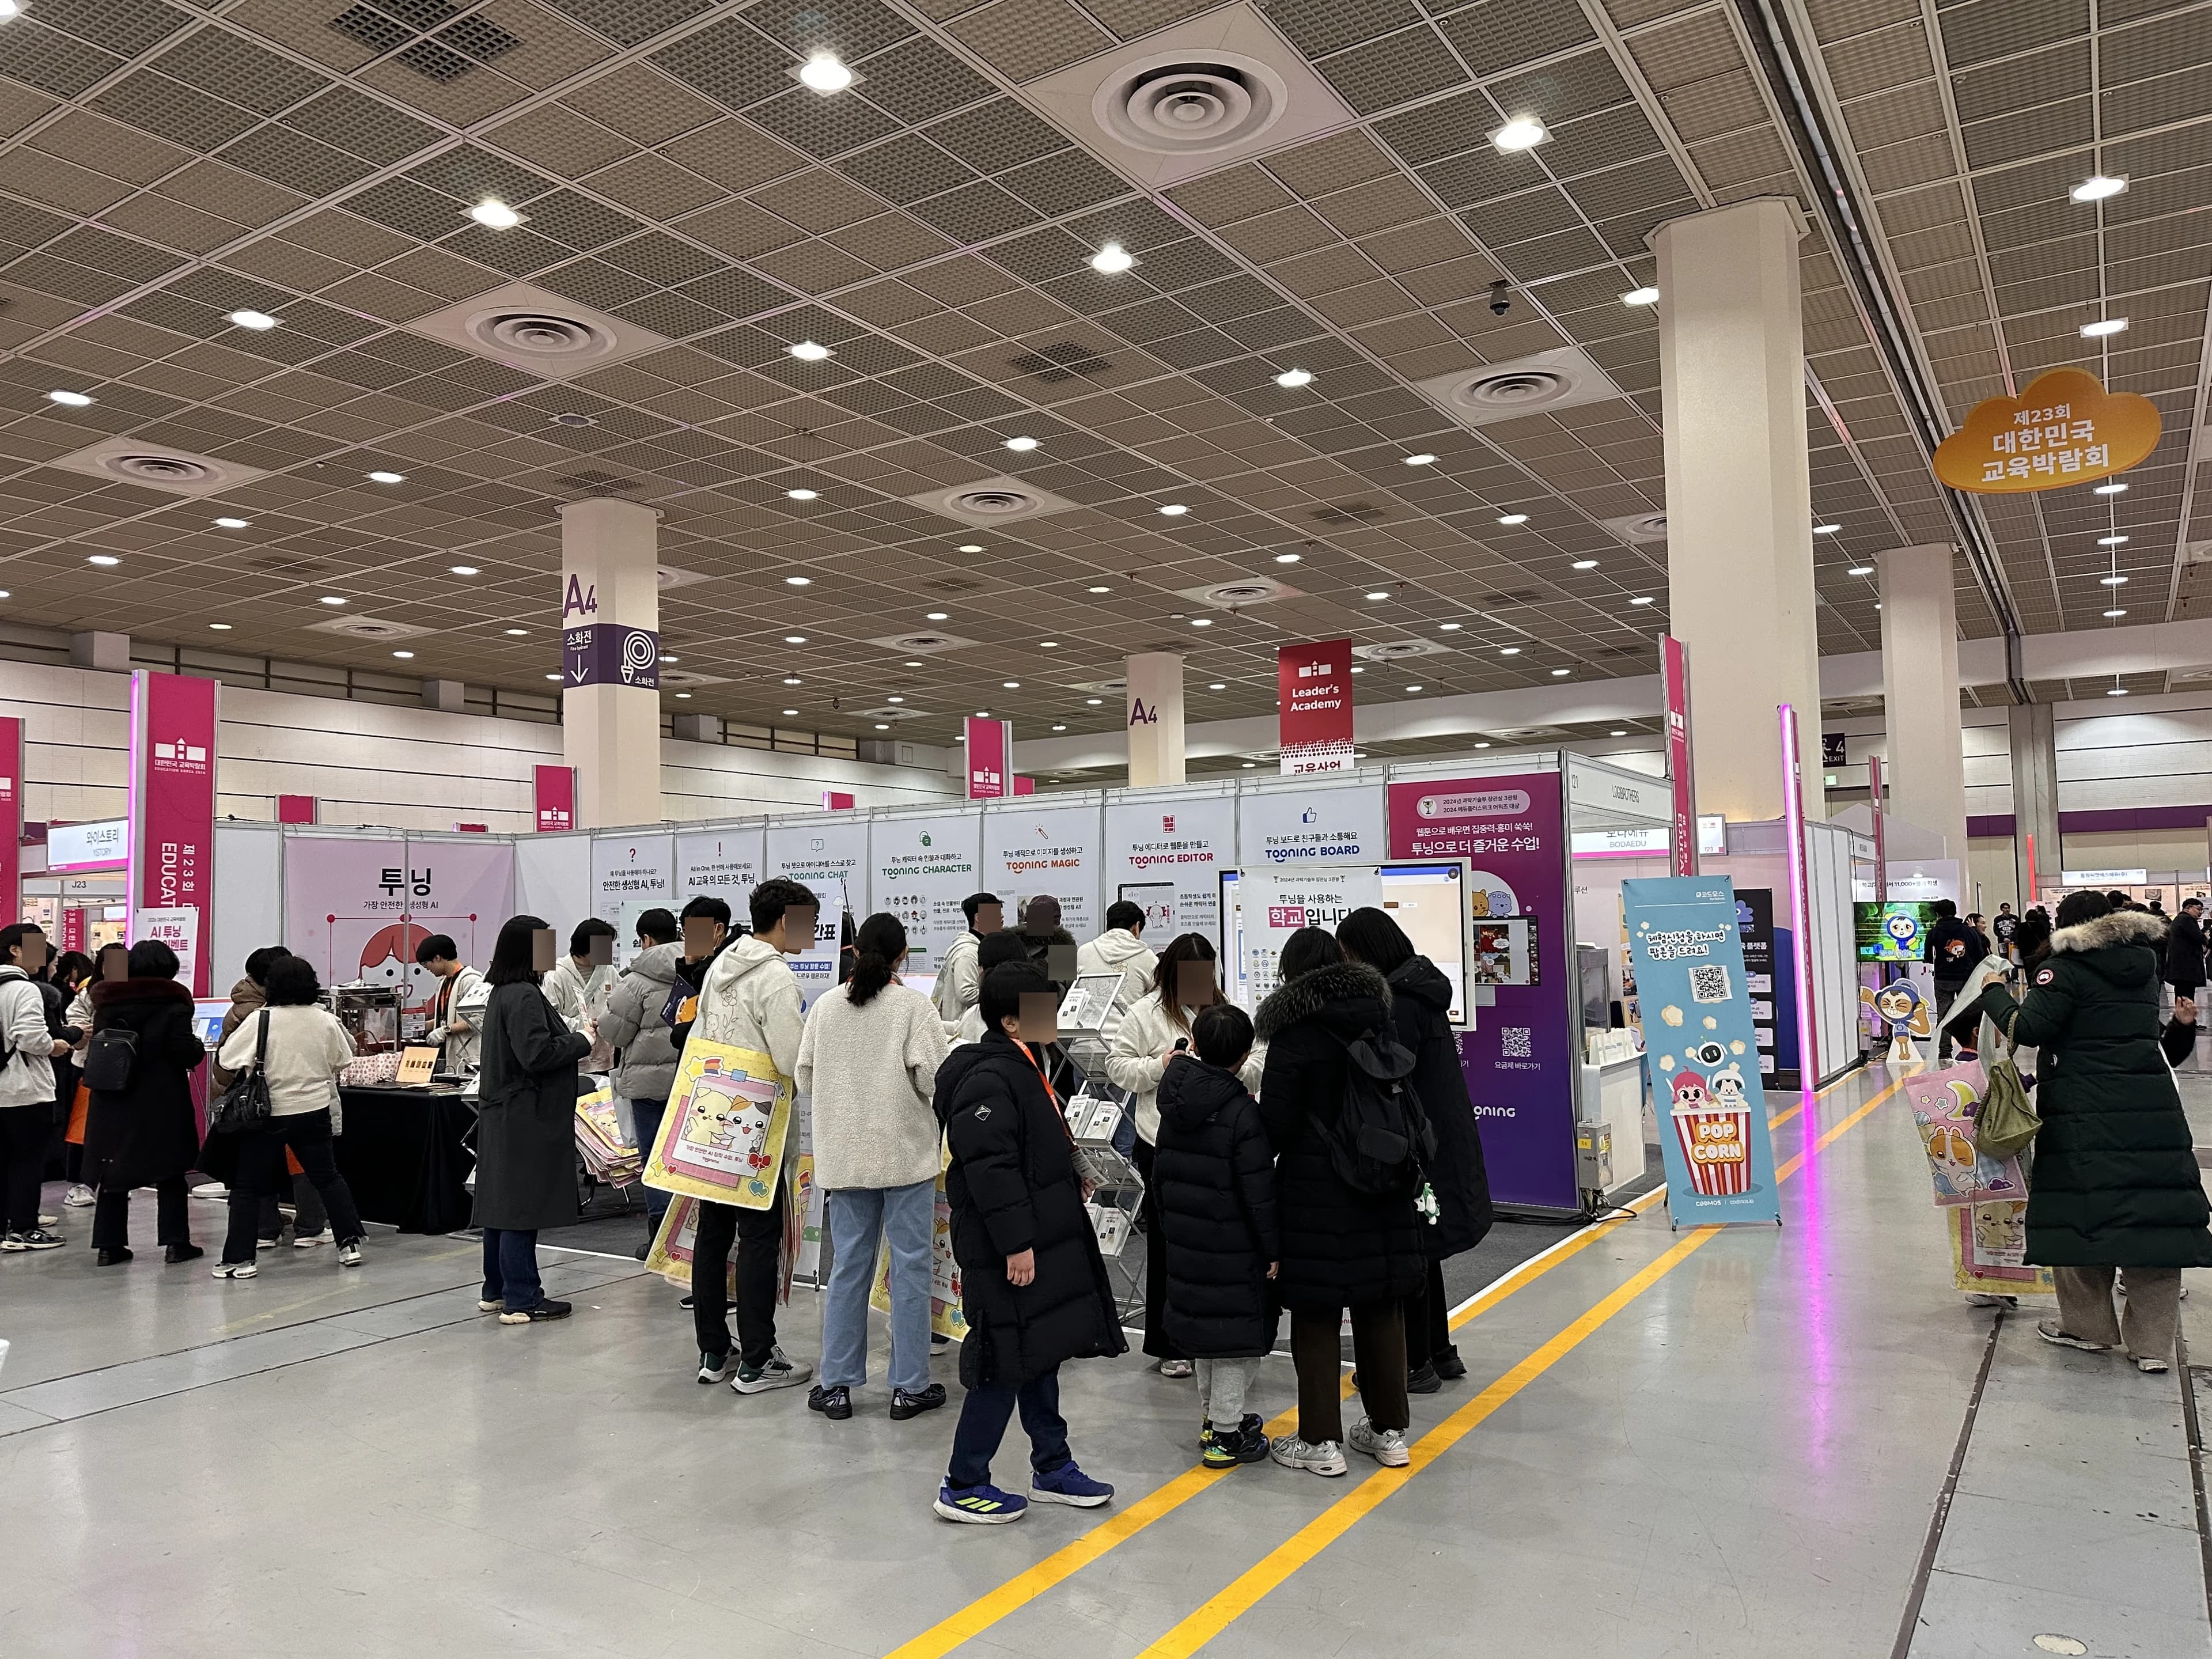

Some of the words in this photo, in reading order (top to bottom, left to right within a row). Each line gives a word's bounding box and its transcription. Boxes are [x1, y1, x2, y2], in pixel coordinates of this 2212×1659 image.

[2014, 404, 2071, 425] 제23회
[1993, 419, 2095, 453] 대한민국
[1982, 444, 2109, 482] 교육박람회
[562, 574, 597, 618] A4
[567, 630, 592, 646] 소화전
[635, 676, 654, 687] 소화전
[1292, 684, 1339, 698] Leader's
[1130, 698, 1157, 726] A4
[1290, 699, 1342, 712] Academy
[1836, 741, 1844, 753] 4
[1416, 827, 1446, 836] 웹툰으로
[1447, 825, 1470, 835] 배우면
[1514, 823, 1533, 831] 쑥쑥!
[86, 828, 119, 845] 와이스토리
[1266, 836, 1279, 844] 투닝
[1281, 835, 1300, 843] 보드로
[1301, 834, 1328, 843] 친구들과
[1330, 831, 1358, 841] 소통해요
[1037, 848, 1059, 856] 이미지를
[1060, 847, 1083, 855] 생성하고
[1145, 843, 1169, 851] 에디터로
[1170, 841, 1189, 850] 웹툰을
[1190, 840, 1209, 849] 만들고
[1320, 845, 1360, 856] BOARD
[1411, 841, 1458, 855] 투닝으로
[1459, 839, 1471, 854] 더
[1473, 838, 1509, 853] 즐거운
[1511, 836, 1540, 851] 수업!
[93, 848, 111, 857] YSTORY
[902, 855, 917, 863] 캐릭터
[940, 853, 961, 861] 대화하고
[1177, 853, 1213, 862] EDITOR
[922, 864, 972, 874] CHARACTER
[1051, 859, 1080, 868] MAGIC
[688, 877, 695, 885] AI
[696, 875, 716, 886] 교육의
[717, 874, 730, 884] 모든
[732, 874, 740, 885] 것,
[741, 873, 755, 884] 투닝
[828, 870, 849, 878] CHAT
[378, 868, 431, 896] 투닝
[603, 880, 620, 891] 안전한
[622, 880, 639, 890] 생성형
[650, 878, 665, 889] 투닝!
[363, 901, 378, 909] 가장
[380, 901, 403, 909] 안전한
[409, 901, 429, 909] 생성형
[1279, 894, 1305, 904] 투닝을
[1308, 894, 1343, 904] 사용하는
[150, 926, 161, 938] AI
[164, 925, 181, 938] 투닝
[815, 924, 835, 941] 간표
[1648, 931, 1694, 944] 체험신청을
[1696, 931, 1724, 940] 하시면
[1649, 946, 1675, 958] 팝콘을
[1679, 945, 1708, 955] 드려요!
[1494, 1061, 1514, 1070] 요금제
[1514, 1062, 1541, 1071] 바로가기
[1474, 1105, 1516, 1118] ONING
[1699, 1123, 1734, 1139] POP
[1694, 1143, 1741, 1160] CORN
